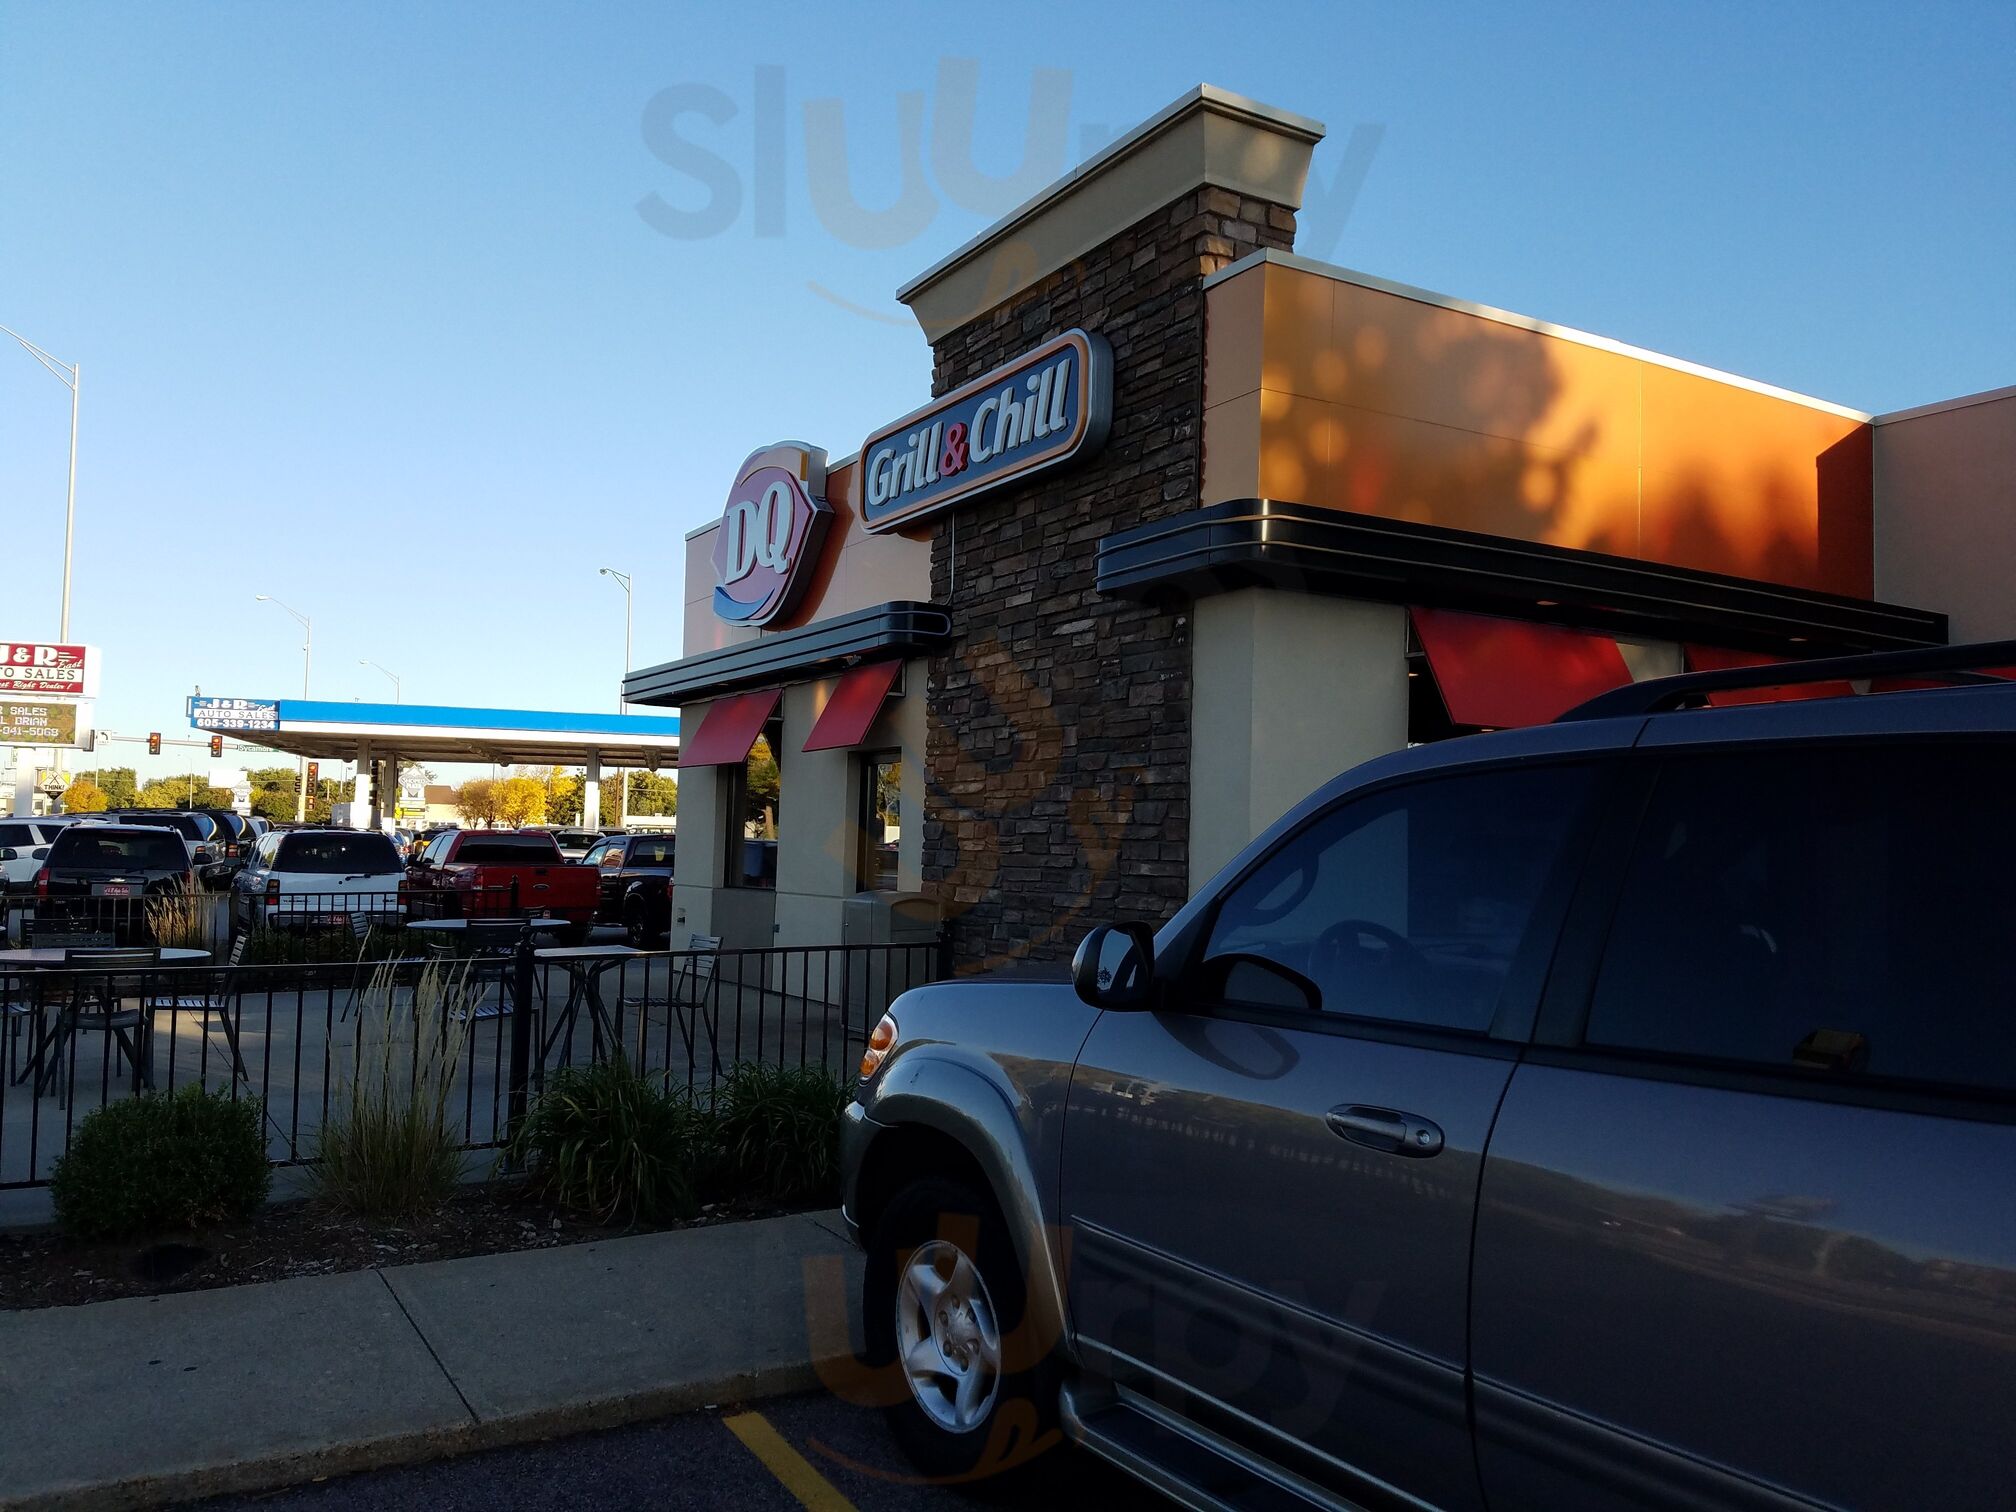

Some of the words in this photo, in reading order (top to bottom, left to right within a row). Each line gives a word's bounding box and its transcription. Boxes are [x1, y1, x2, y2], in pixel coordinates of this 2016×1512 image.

[725, 480, 793, 585] DQ
[24, 668, 75, 680] SALES
[10, 706, 48, 716] SALES
[198, 710, 232, 718] AUTO
[238, 711, 276, 720] SALES
[15, 717, 48, 727] BRIAN
[196, 718, 276, 729] 605-339-1234
